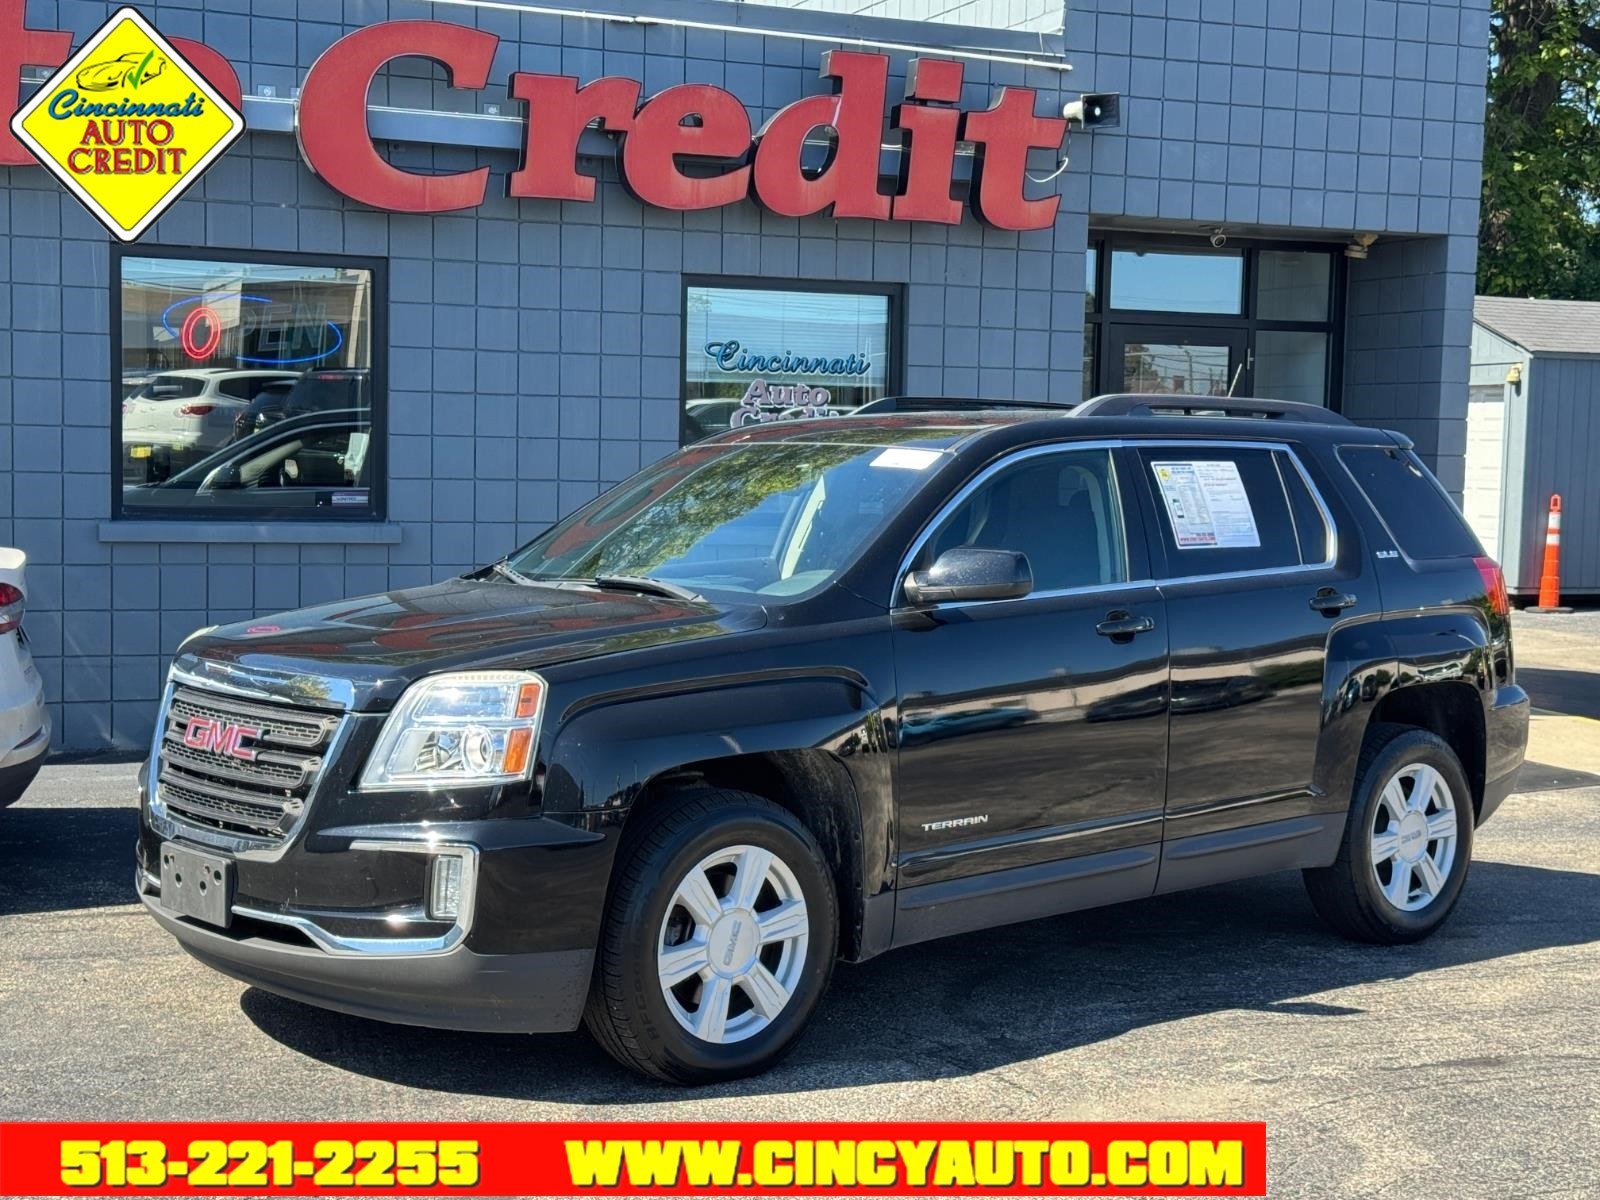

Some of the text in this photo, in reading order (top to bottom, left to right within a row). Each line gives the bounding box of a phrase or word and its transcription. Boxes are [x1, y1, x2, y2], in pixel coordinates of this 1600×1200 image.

[298, 20, 1067, 230] Credit
[704, 339, 871, 375] Cincinnati
[741, 379, 831, 407] Auto
[183, 716, 261, 761] GMC
[921, 814, 989, 832] TERRAIN
